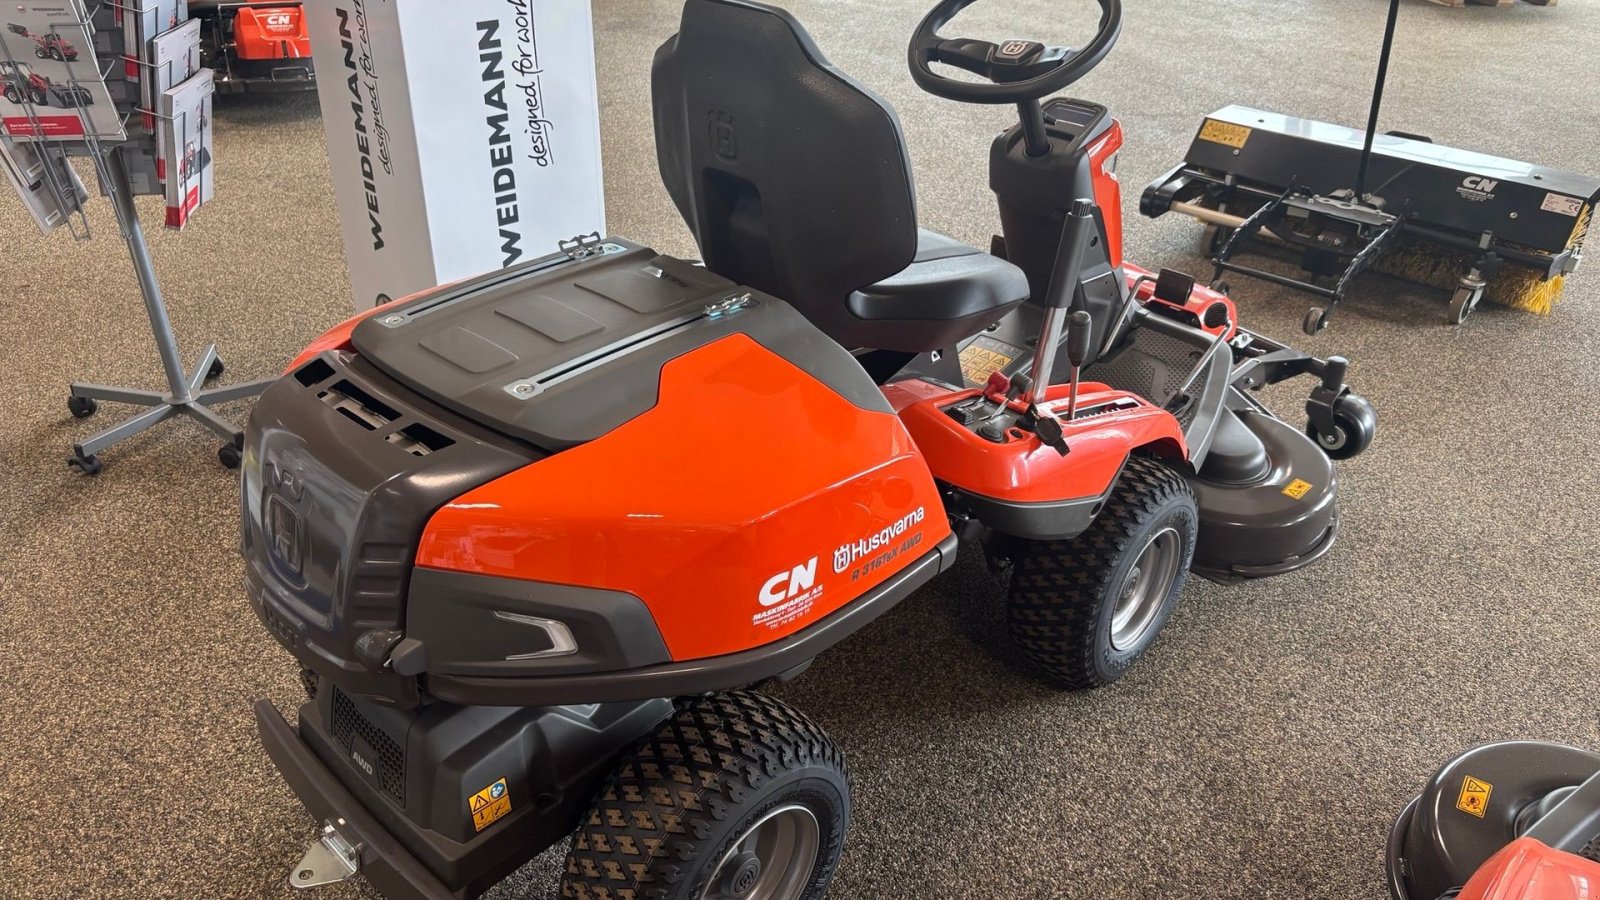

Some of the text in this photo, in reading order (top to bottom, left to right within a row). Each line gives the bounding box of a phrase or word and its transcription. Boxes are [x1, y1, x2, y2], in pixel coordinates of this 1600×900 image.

[266, 15, 290, 25] CN
[357, 43, 379, 79] for
[512, 44, 544, 77] for
[335, 7, 387, 251] WEIDEMANN
[362, 81, 392, 175] designed
[515, 81, 554, 168] designed
[476, 19, 522, 268] WEIDEMANN
[1462, 175, 1498, 192] CN
[851, 506, 925, 562] Husqvarna
[900, 531, 923, 552] AWD
[758, 556, 819, 607] CN
[752, 591, 811, 621] MASKINFABRIK
[352, 752, 374, 776] AWD
